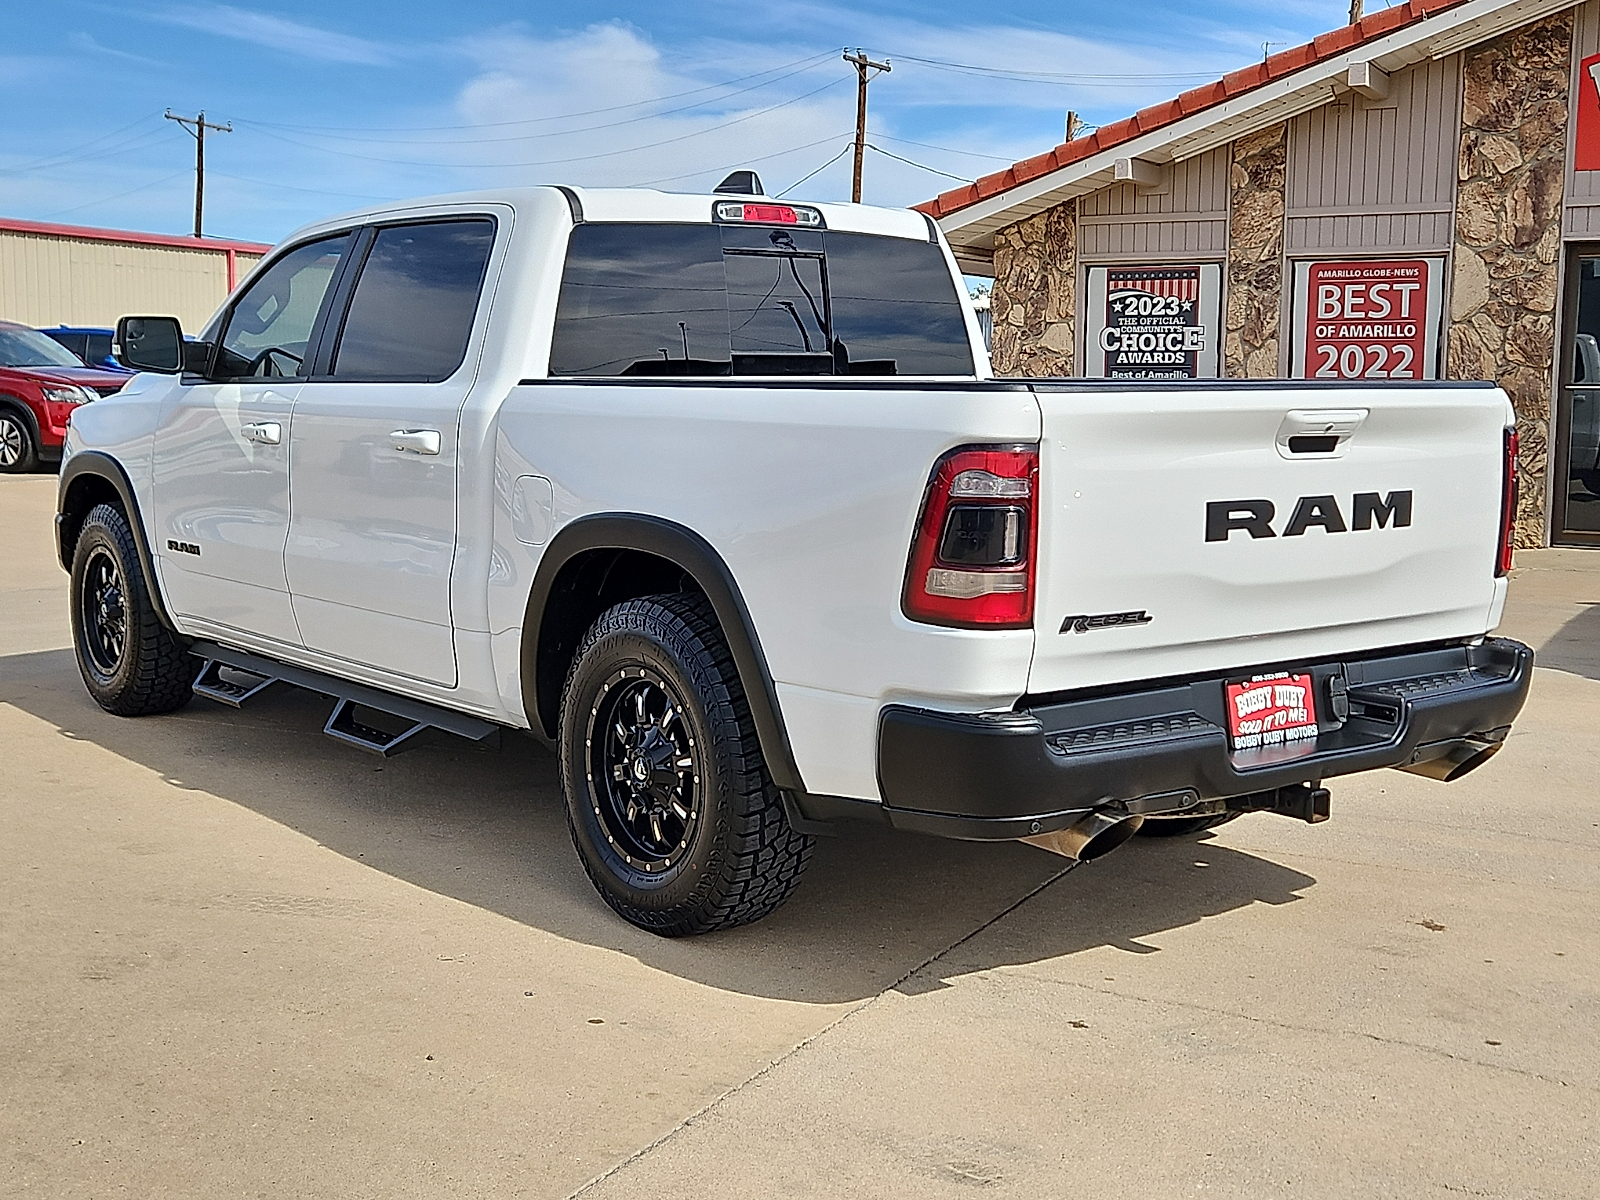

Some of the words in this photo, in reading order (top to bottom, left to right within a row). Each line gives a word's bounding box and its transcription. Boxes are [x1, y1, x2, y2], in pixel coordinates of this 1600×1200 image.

[1317, 269, 1361, 278] AMARILLO
[1363, 268, 1420, 277] GLOBE-NEWS
[1124, 297, 1180, 316] 2023
[1317, 283, 1420, 319] BEST
[1118, 317, 1137, 326] THE
[1139, 316, 1186, 325] OFFICIAL
[1121, 325, 1184, 333] COMMUNITY'S
[1315, 325, 1336, 338] OF
[1338, 324, 1416, 338] AMARILLO
[1099, 326, 1205, 351] CHOICE
[1116, 352, 1185, 364] AWARDS
[1315, 344, 1415, 378] 2022
[1112, 370, 1133, 379] Best
[1136, 370, 1146, 379] of
[1149, 370, 1189, 379] Amarillo
[1204, 490, 1413, 542] RAM
[167, 539, 201, 556] RAM
[1059, 610, 1153, 634] REBEL
[1235, 686, 1273, 718] BOBBY
[1274, 685, 1306, 708] DUBY
[1238, 719, 1263, 734] SOLD
[1263, 715, 1274, 731] IT
[1274, 710, 1287, 726] TO
[1288, 708, 1308, 722] ME!
[1234, 734, 1262, 749] BOBBY
[1263, 730, 1285, 745] DUBY
[1286, 724, 1318, 740] MOTORS
